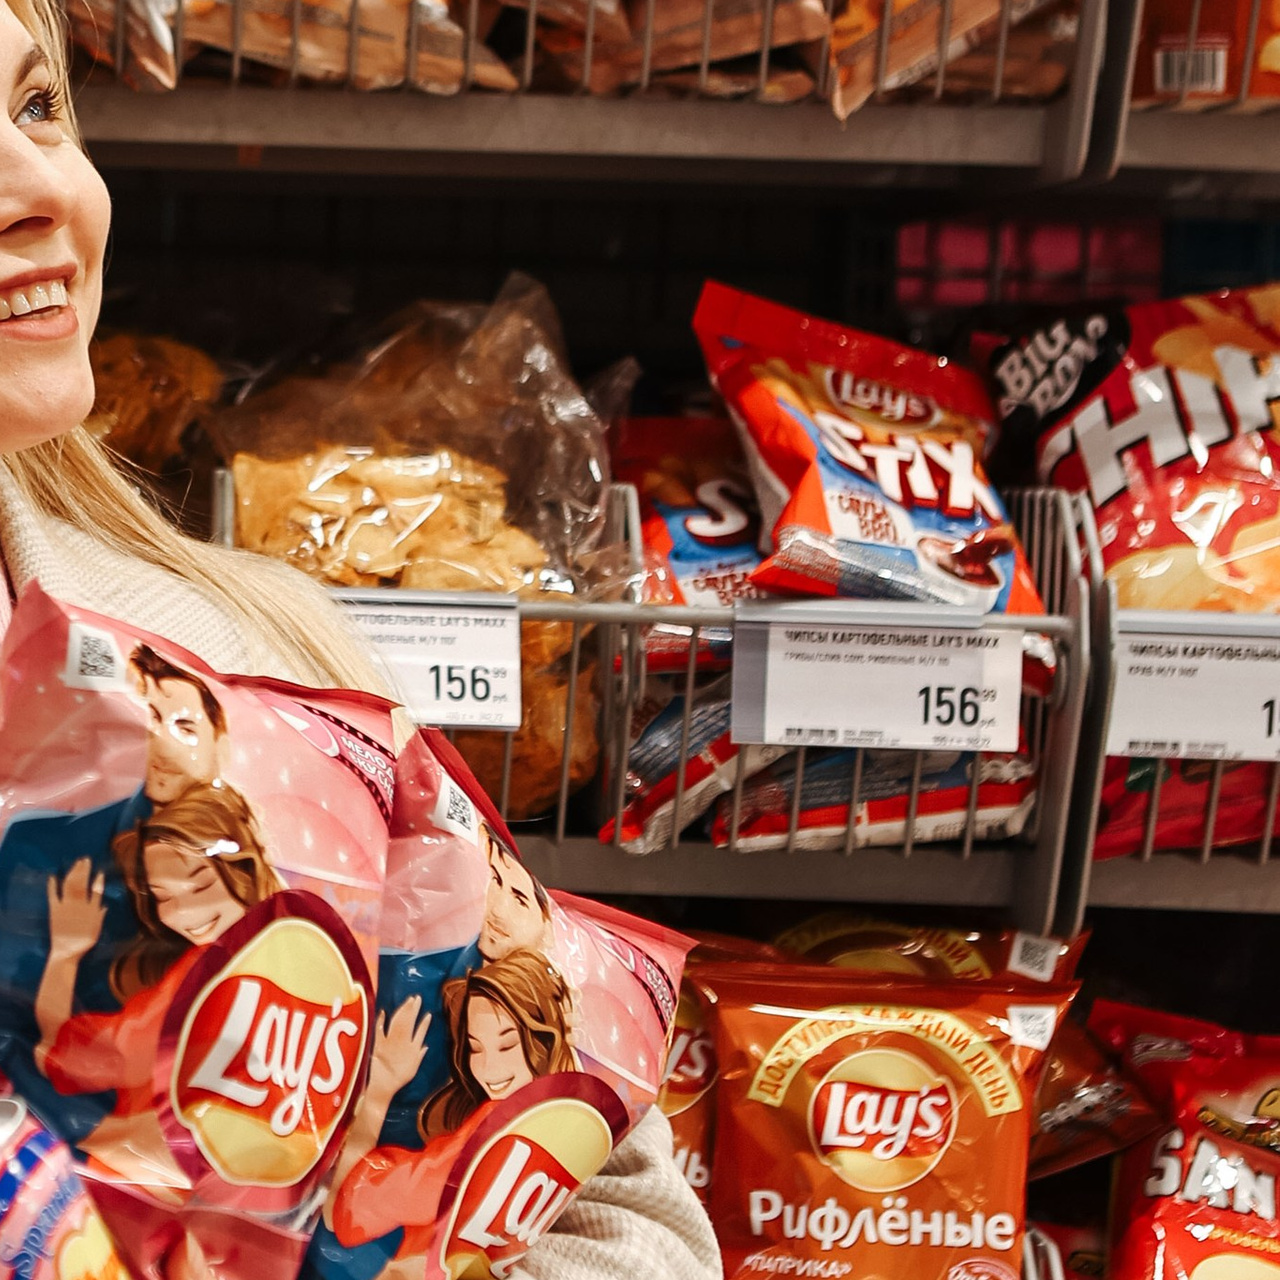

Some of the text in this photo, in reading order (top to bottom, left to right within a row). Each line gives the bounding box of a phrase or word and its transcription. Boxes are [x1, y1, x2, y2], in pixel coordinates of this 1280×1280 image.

[784, 629, 830, 644] ЧИПСЫ
[831, 632, 929, 647] КАРТОФЕЛЬНЫЕ
[932, 634, 963, 648] LAY'S
[429, 664, 491, 703] 156
[493, 666, 508, 679] 99
[918, 685, 980, 726] 156
[186, 978, 359, 1137] Lay's
[964, 1051, 1011, 1110] ДЕНЬ
[820, 1082, 950, 1161] Lay's
[748, 1188, 1017, 1252] Рифлёные
